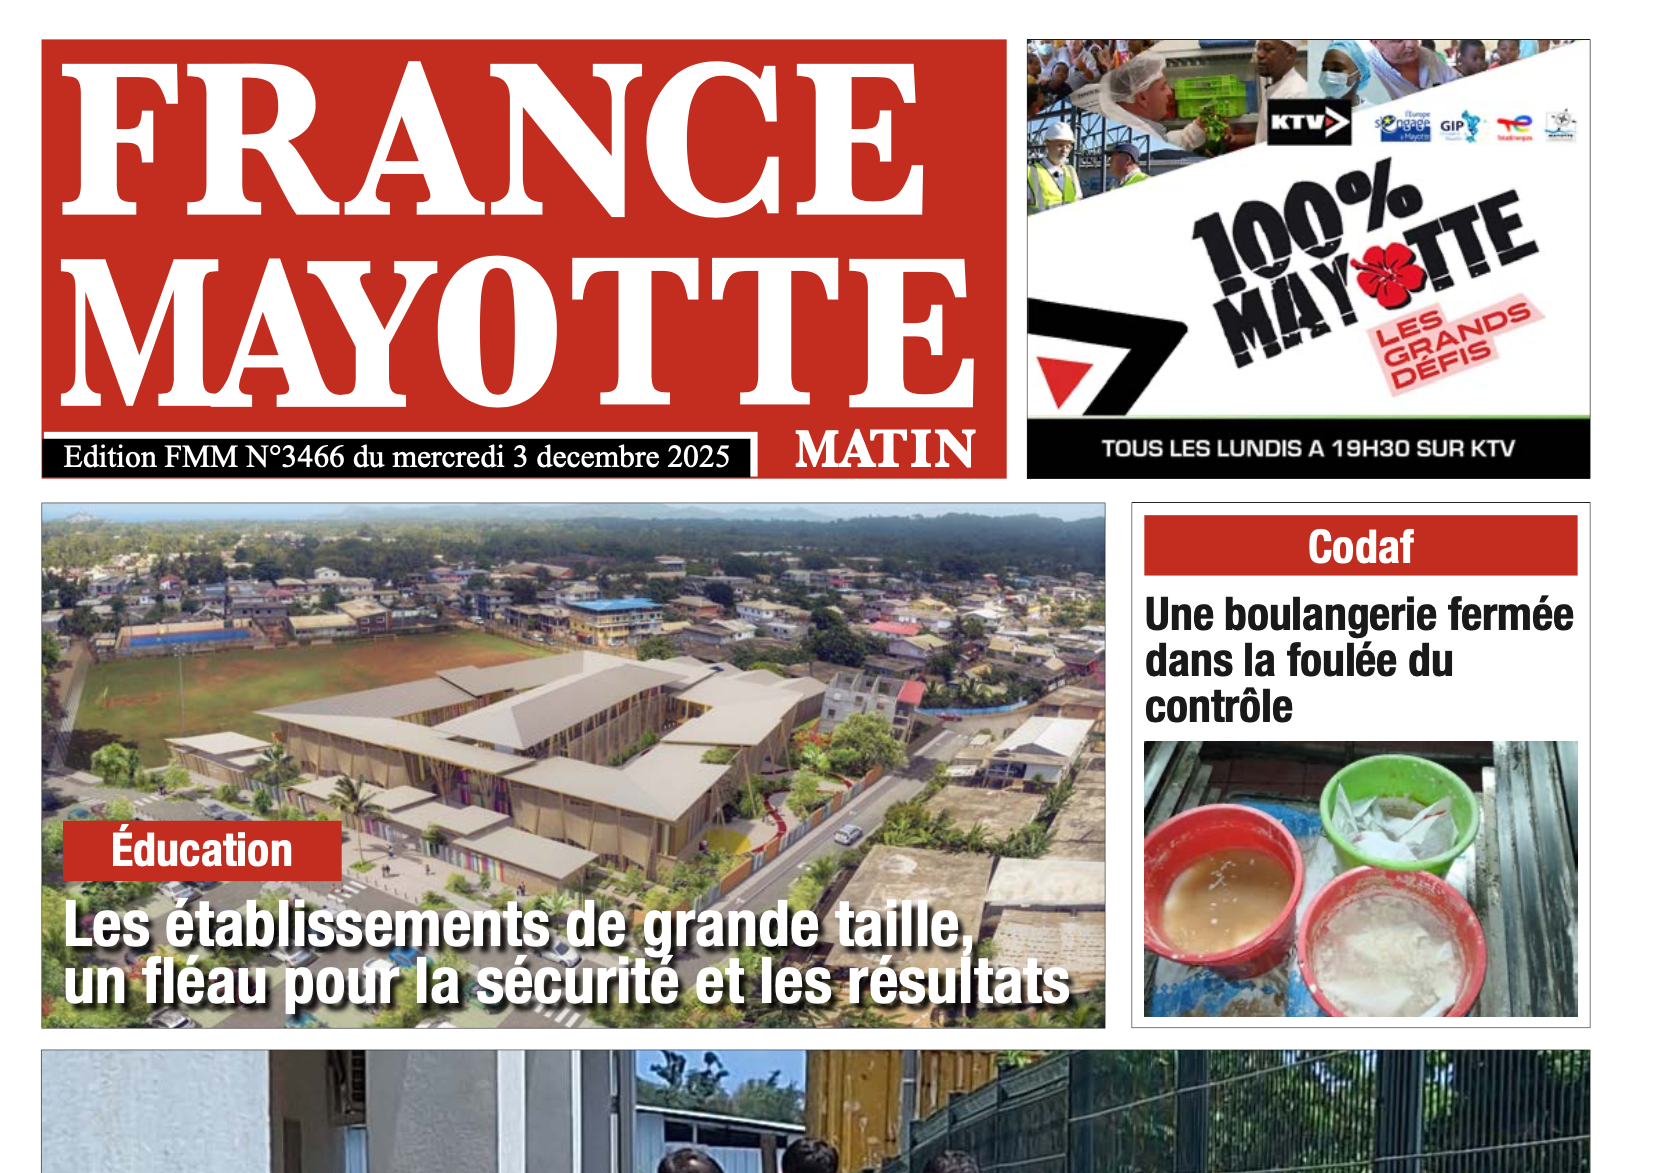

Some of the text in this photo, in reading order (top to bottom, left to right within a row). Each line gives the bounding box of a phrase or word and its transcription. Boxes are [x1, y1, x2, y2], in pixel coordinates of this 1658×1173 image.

[61, 60, 924, 218] FRANCE
[1271, 114, 1325, 130] KTV
[1440, 120, 1465, 132] GIP
[1192, 156, 1424, 297] 100%
[60, 255, 975, 409] MAYOTTE
[1376, 309, 1443, 348] LES
[1384, 302, 1532, 368] GRANDS
[1391, 339, 1492, 390] DÉFIS
[63, 444, 730, 468] Edition FMM N°3466 du mercredi 3 decembre 2025
[795, 428, 977, 469] MATIN
[1101, 439, 1516, 457] TOUS LES LUNDIS A 19H30 SUR KTV
[1308, 528, 1415, 564] Codaf
[1146, 594, 1574, 638] Une boulangerie fermée
[1145, 640, 1453, 677] dans la foulée du
[1145, 686, 1293, 723] contrôle
[112, 824, 292, 867] Éducation
[65, 897, 974, 958] Les établissements de grande taille,
[65, 954, 1070, 1015] un fléau pour la sécurité et les résultats
